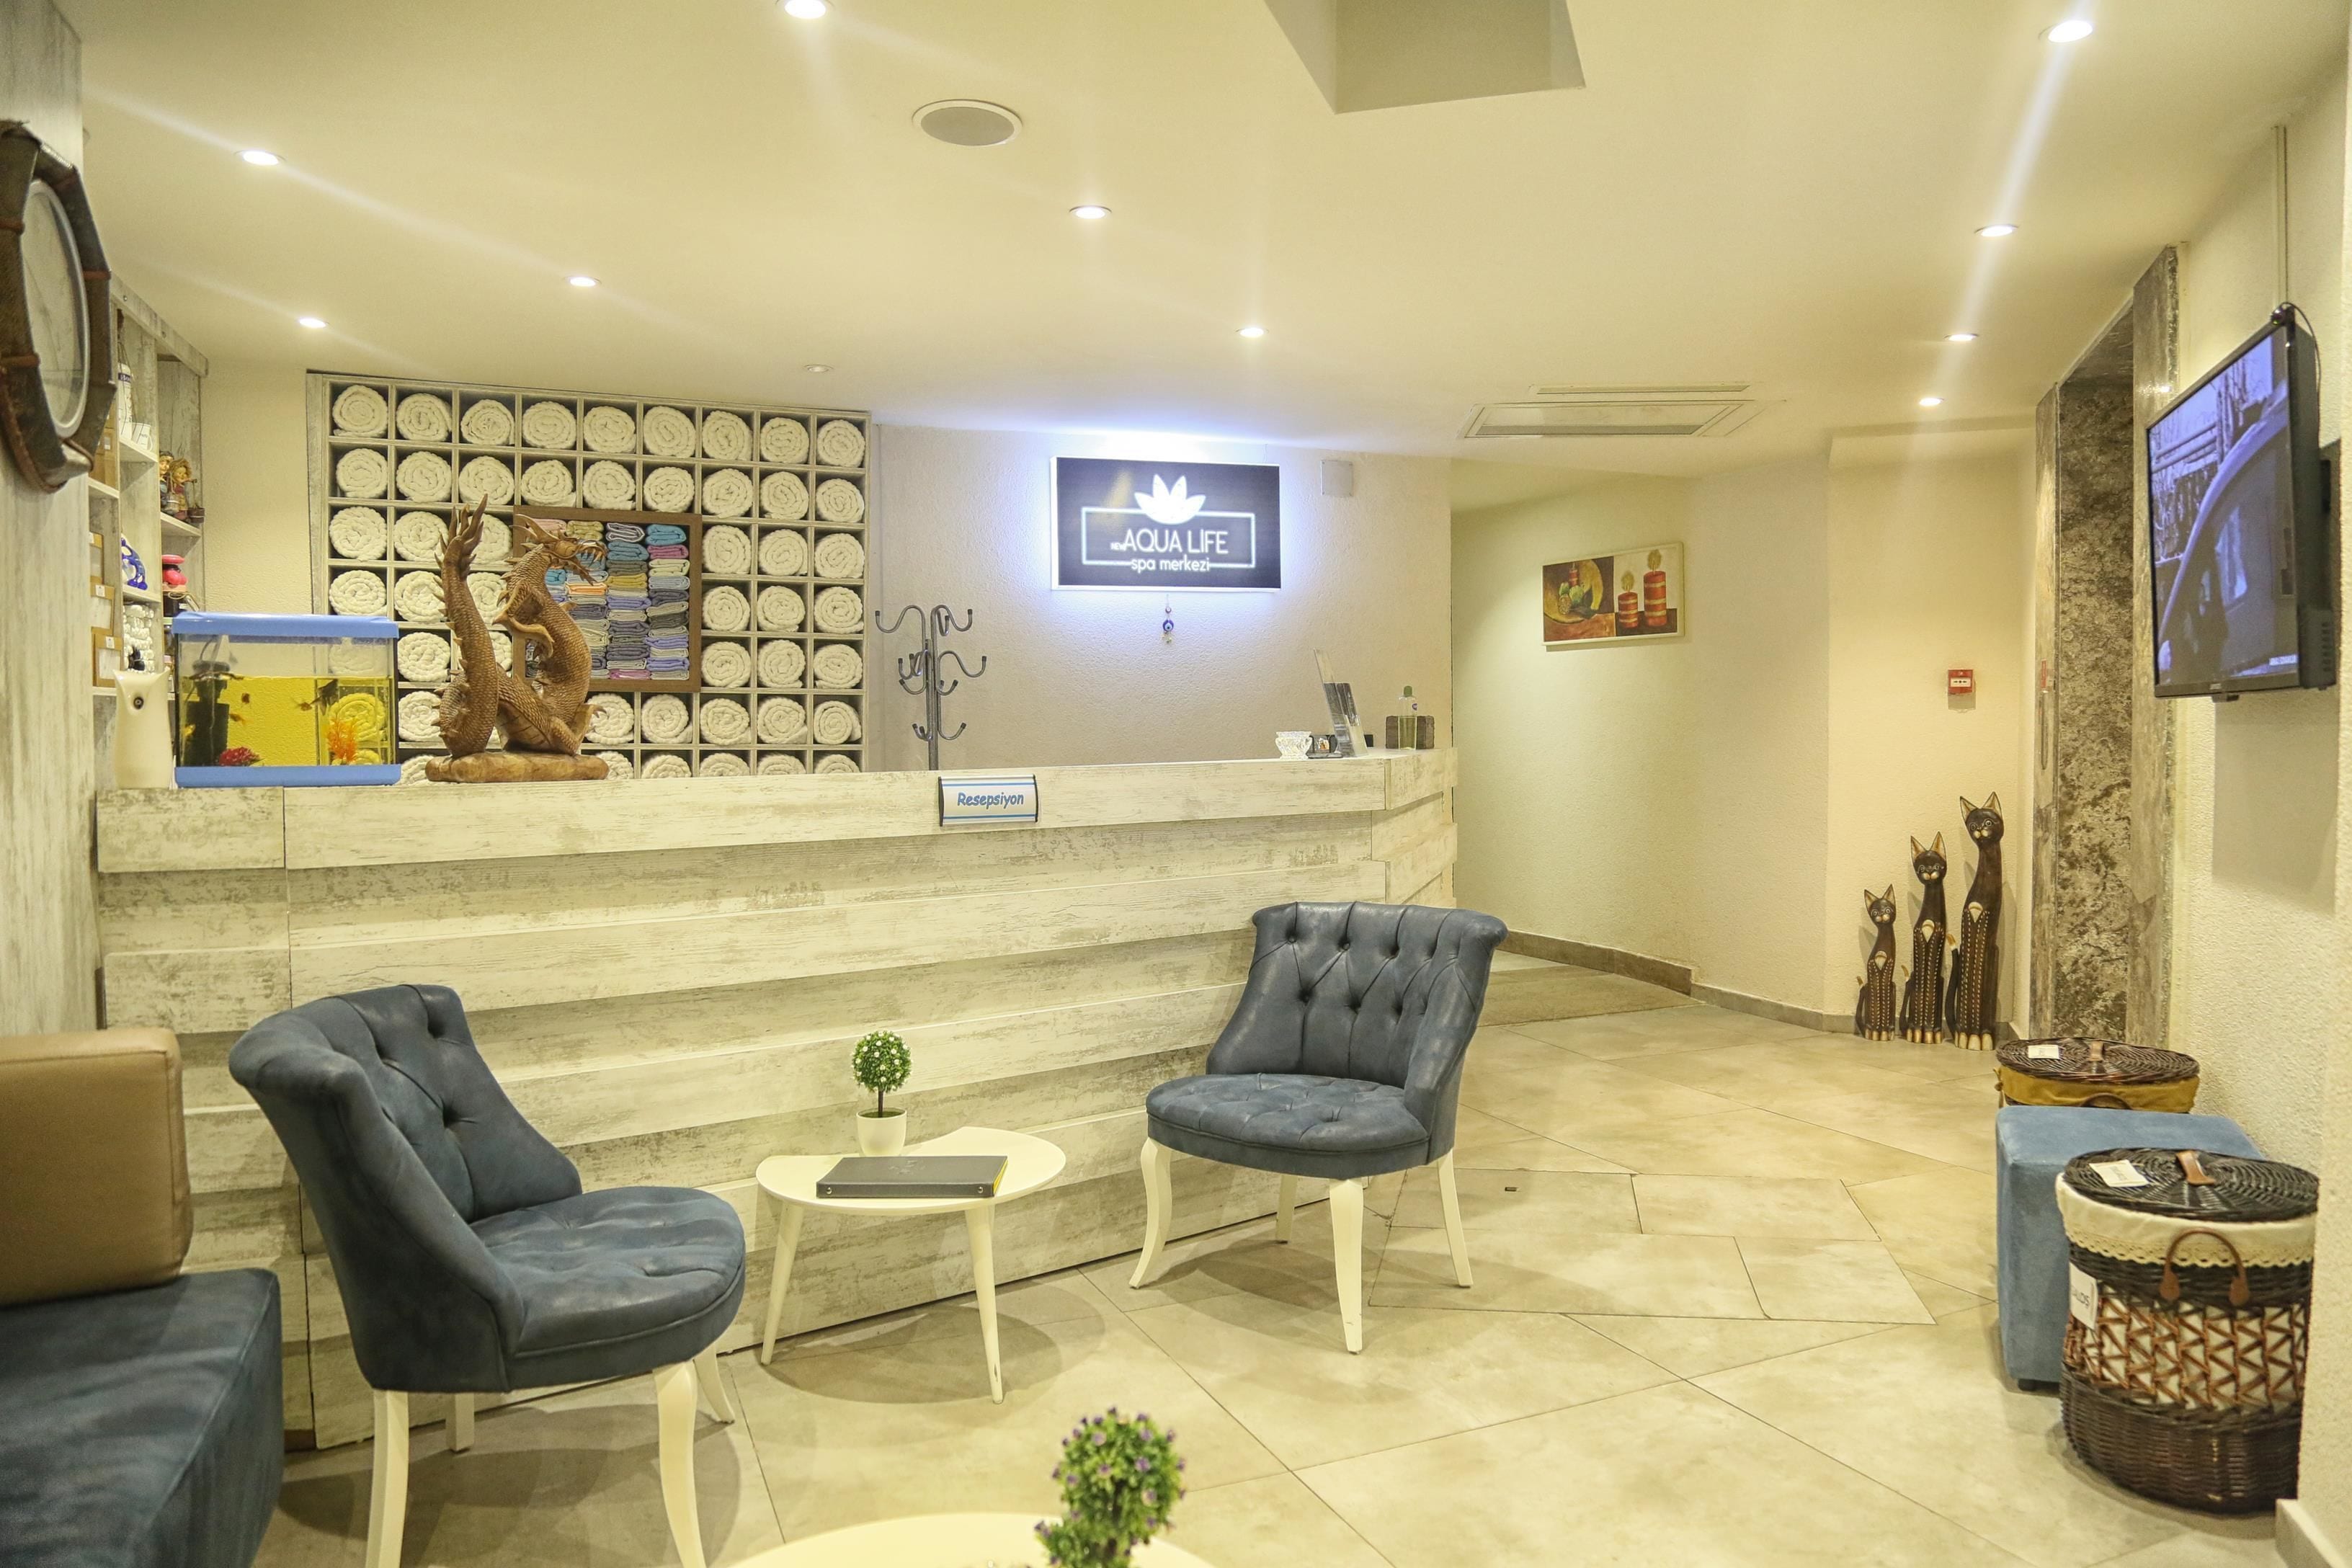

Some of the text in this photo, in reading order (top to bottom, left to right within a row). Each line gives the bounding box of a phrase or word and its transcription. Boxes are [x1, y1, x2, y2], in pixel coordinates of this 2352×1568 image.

[1123, 527, 1182, 553] AQUA
[1188, 528, 1229, 554] LIFE
[1131, 554, 1211, 574] spa merkezi
[957, 792, 1024, 810] Resepsiyon
